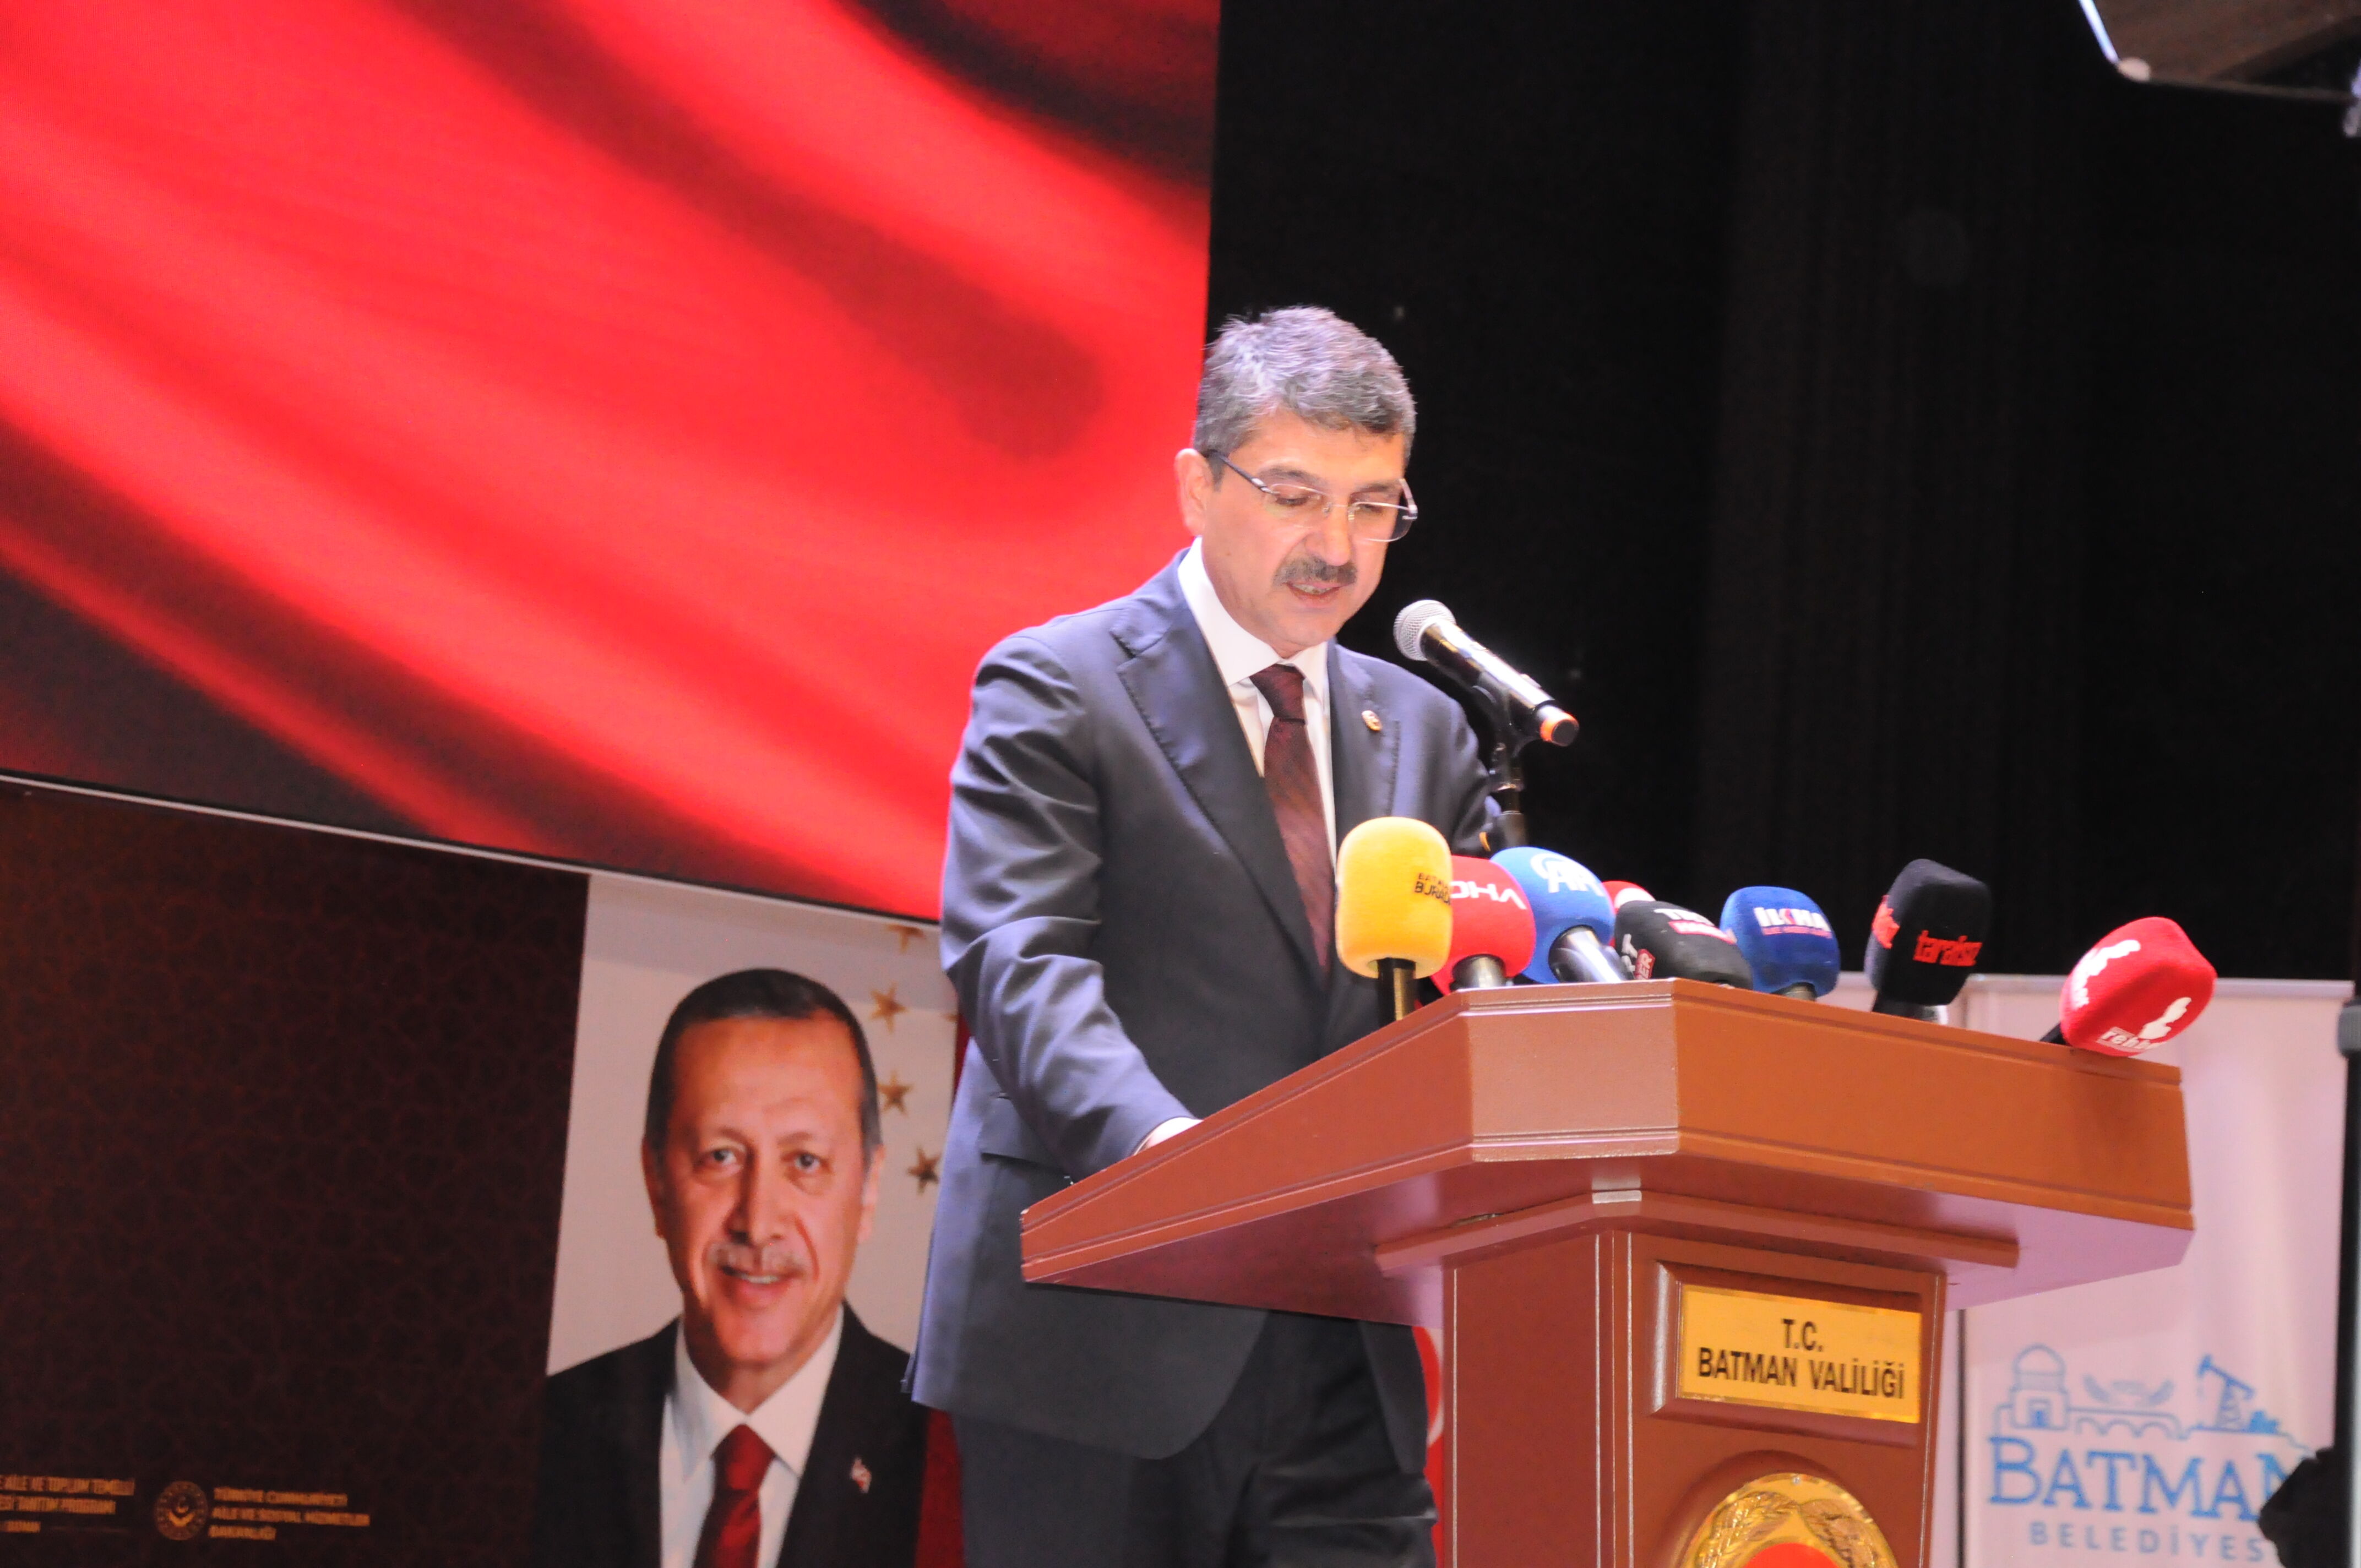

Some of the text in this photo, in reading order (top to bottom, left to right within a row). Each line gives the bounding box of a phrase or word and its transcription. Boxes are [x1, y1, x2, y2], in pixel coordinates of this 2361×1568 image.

[1781, 1318, 1824, 1353] T.C.
[1698, 1347, 1905, 1399] BATMAN VALİLİĞİ
[2029, 1522, 2264, 1562] BELEDİYES
